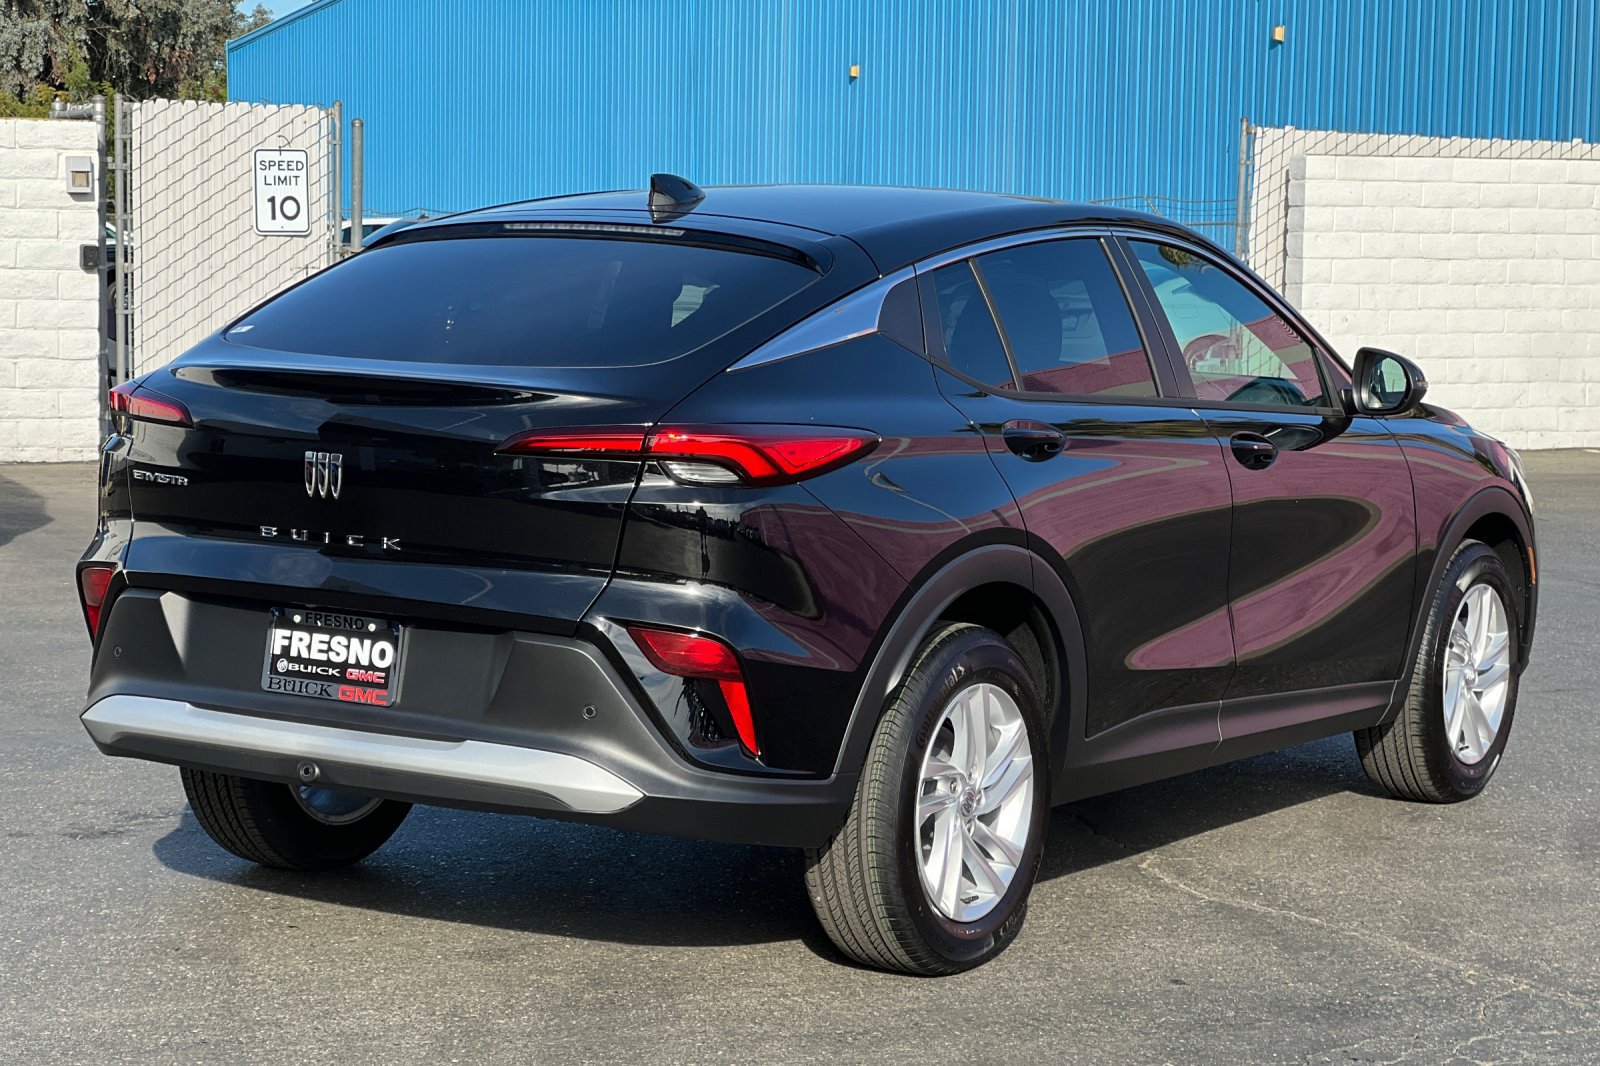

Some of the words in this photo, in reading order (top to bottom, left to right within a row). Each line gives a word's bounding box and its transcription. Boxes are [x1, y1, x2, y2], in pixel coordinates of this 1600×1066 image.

[259, 160, 304, 171] SPEED
[264, 175, 300, 186] LIMIT
[267, 195, 301, 221] 10
[260, 525, 401, 550] BUICK
[305, 611, 364, 630] FRESNO
[272, 629, 394, 668] FRESNO
[288, 663, 341, 677] BUICK
[346, 668, 386, 683] GMC
[267, 676, 333, 697] BUICK
[338, 685, 388, 705] GMC
